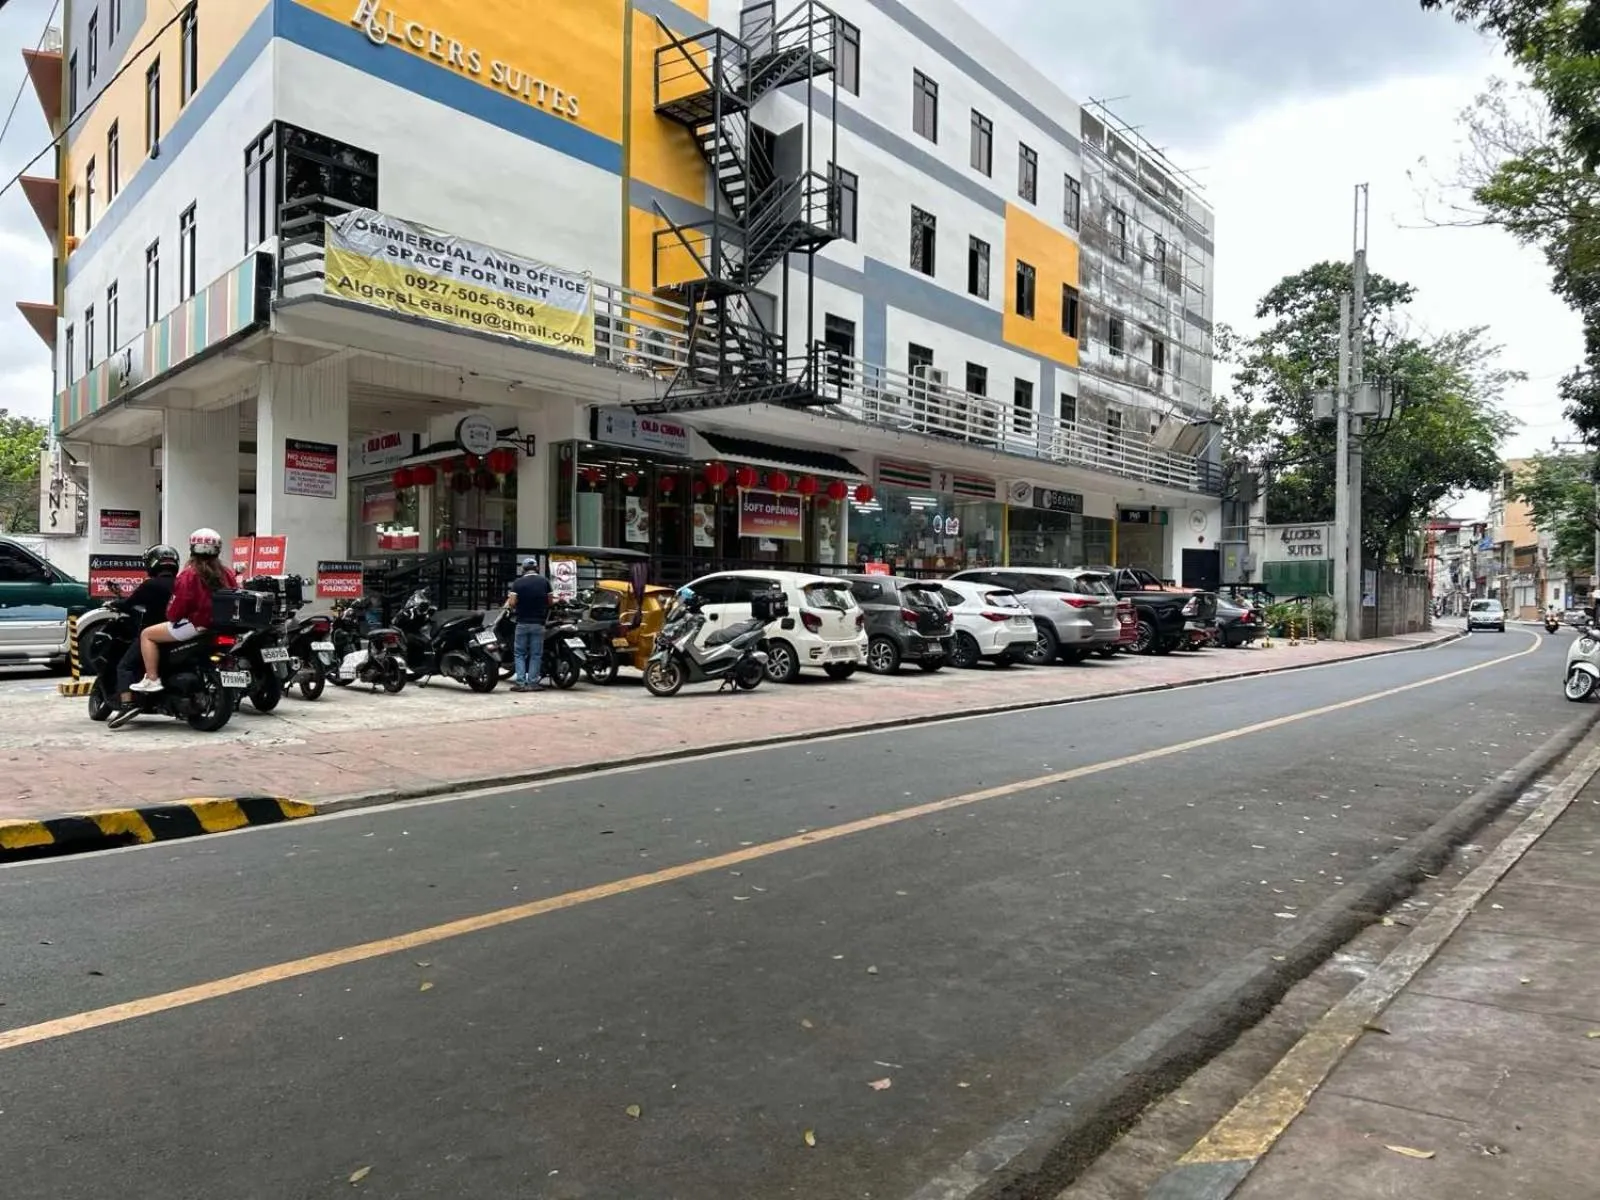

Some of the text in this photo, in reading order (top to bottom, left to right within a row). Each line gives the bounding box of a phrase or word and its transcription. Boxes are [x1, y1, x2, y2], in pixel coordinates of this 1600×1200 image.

[351, 0, 579, 117] ALGERS SUITES
[386, 244, 551, 299] SPACE FOR RENT
[484, 257, 521, 276] AND
[526, 268, 586, 294] OFFICE
[337, 276, 586, 347] AlgersLeasing@gmail.com
[404, 273, 536, 318] 0927-505-6364
[641, 419, 659, 433] OLD
[660, 424, 687, 438] CHINA
[744, 502, 799, 516] SOFT OPENING
[259, 546, 280, 555] PLEASE
[1287, 544, 1323, 557] SUITES
